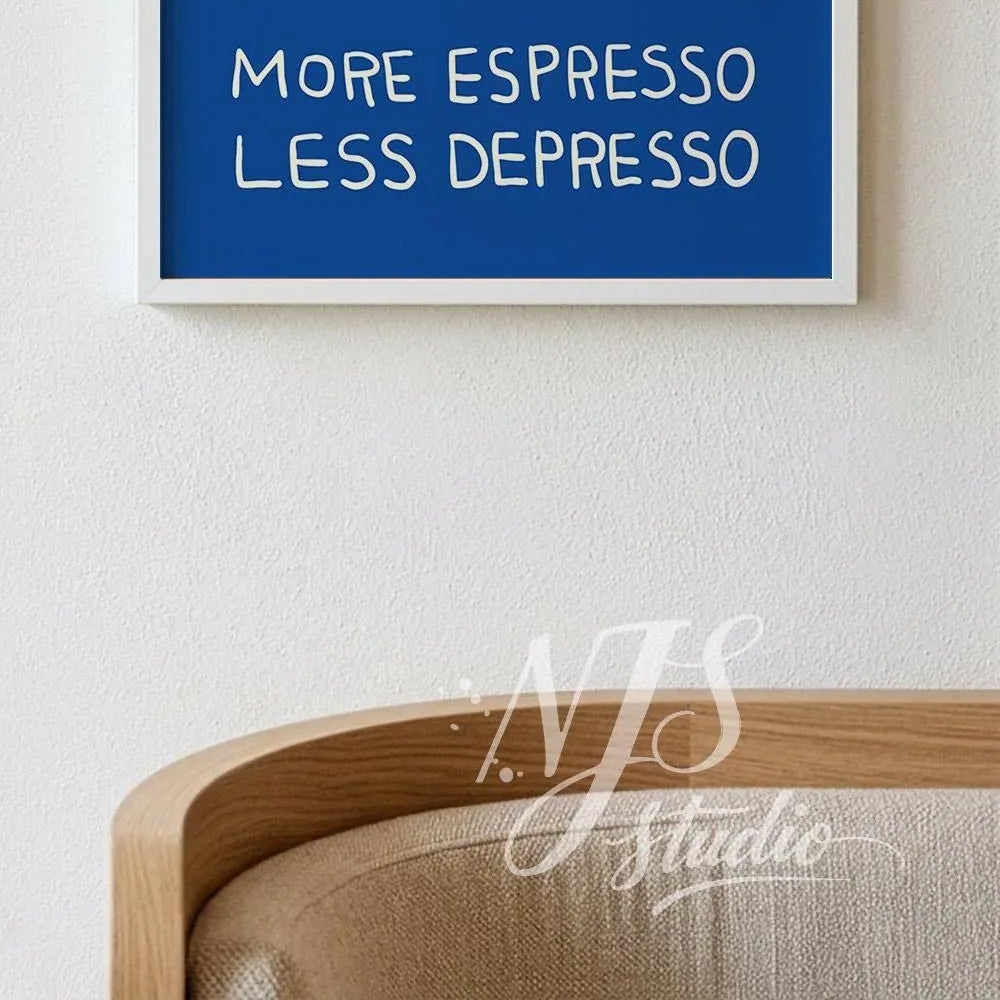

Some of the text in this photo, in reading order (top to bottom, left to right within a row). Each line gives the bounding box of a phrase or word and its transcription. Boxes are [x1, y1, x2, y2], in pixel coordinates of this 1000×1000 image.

[232, 43, 756, 108] MORE ESPRESSO
[235, 129, 759, 190] LESS DEPRESSO
